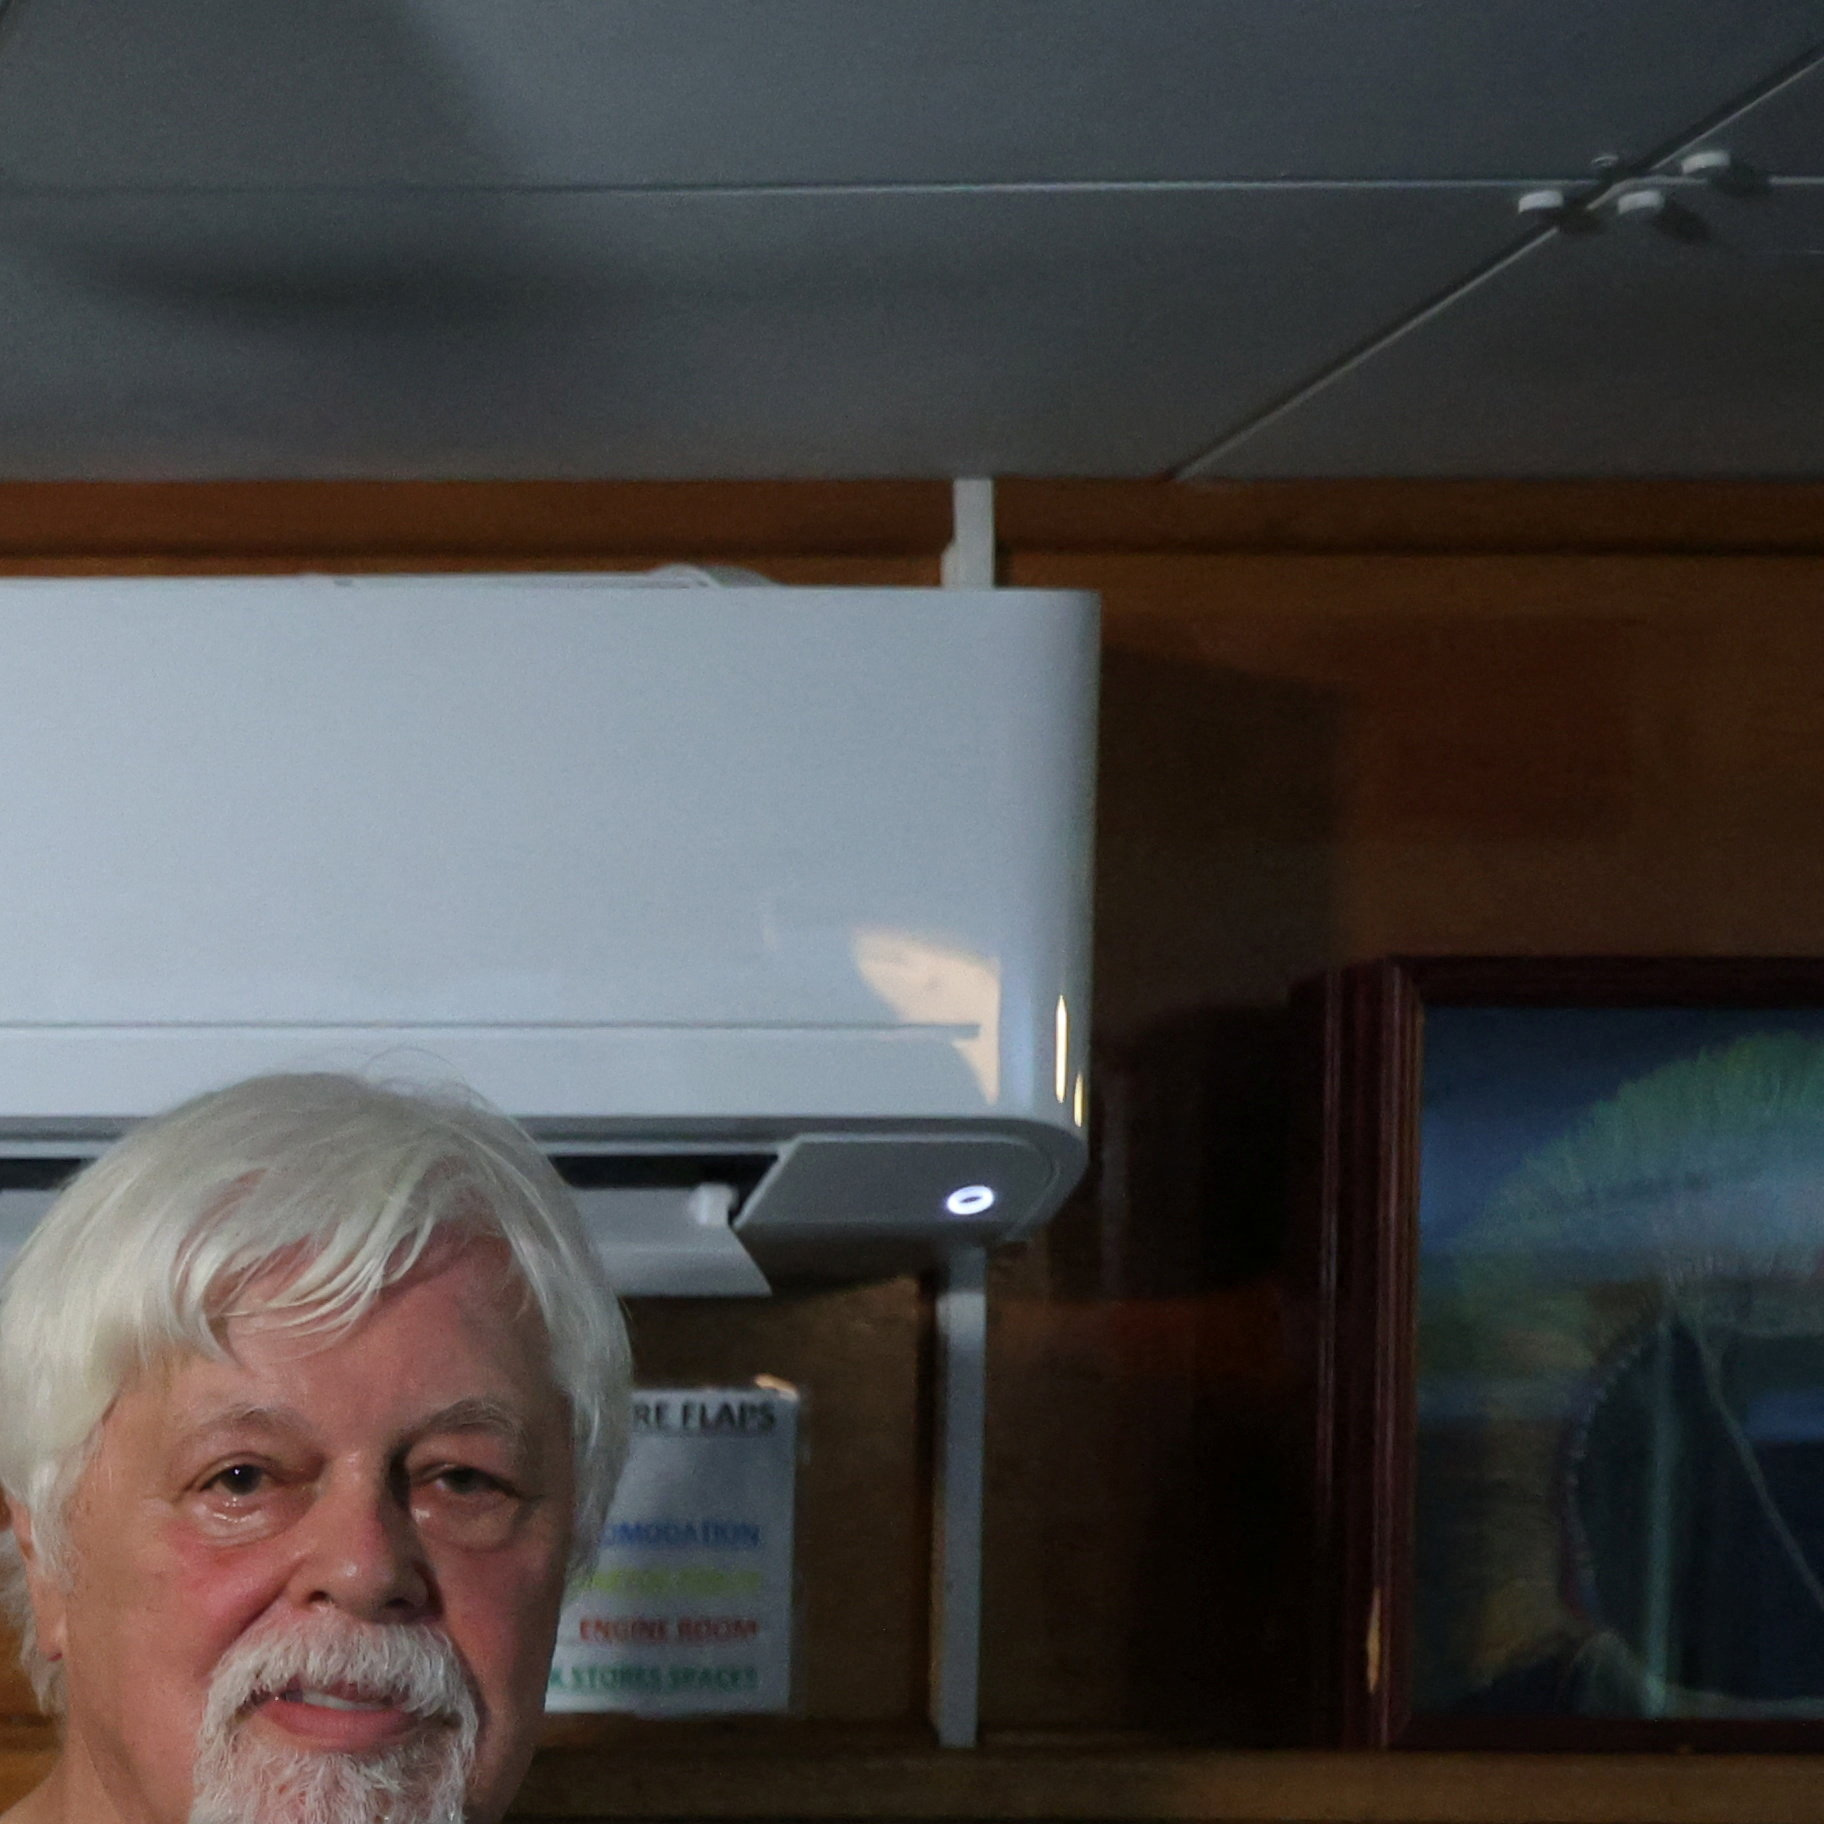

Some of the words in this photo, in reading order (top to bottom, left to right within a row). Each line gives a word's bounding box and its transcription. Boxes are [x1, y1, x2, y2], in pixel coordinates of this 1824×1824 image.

[633, 1403, 670, 1429] RE
[682, 1403, 776, 1432] FLAPS
[601, 1521, 761, 1548] OMODATION
